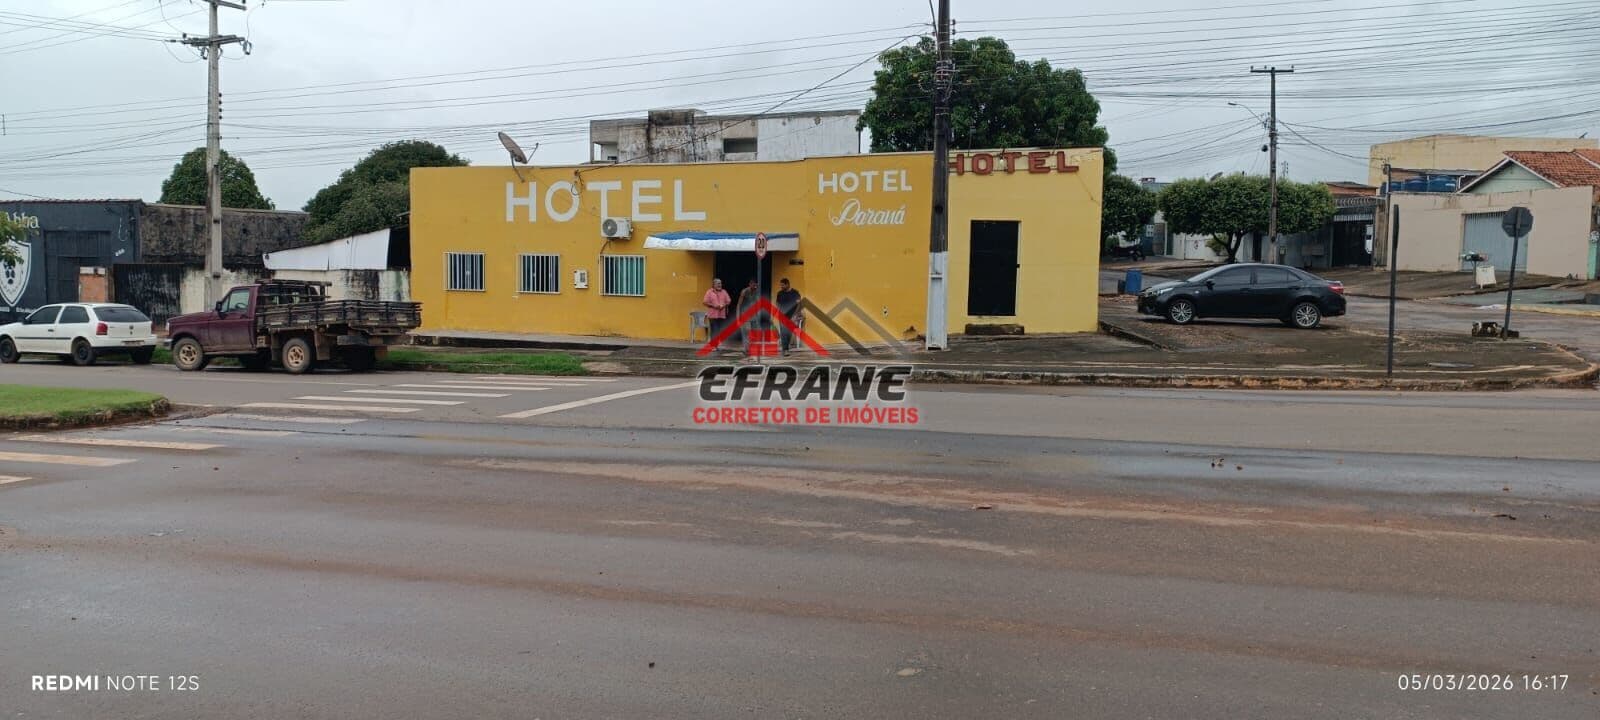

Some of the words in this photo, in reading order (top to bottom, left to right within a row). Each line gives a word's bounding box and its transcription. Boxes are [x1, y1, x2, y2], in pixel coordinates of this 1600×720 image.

[948, 151, 1079, 176] HOTEL
[818, 169, 913, 194] HOTEL
[505, 179, 707, 222] HOTEL
[828, 198, 906, 226] Paraná
